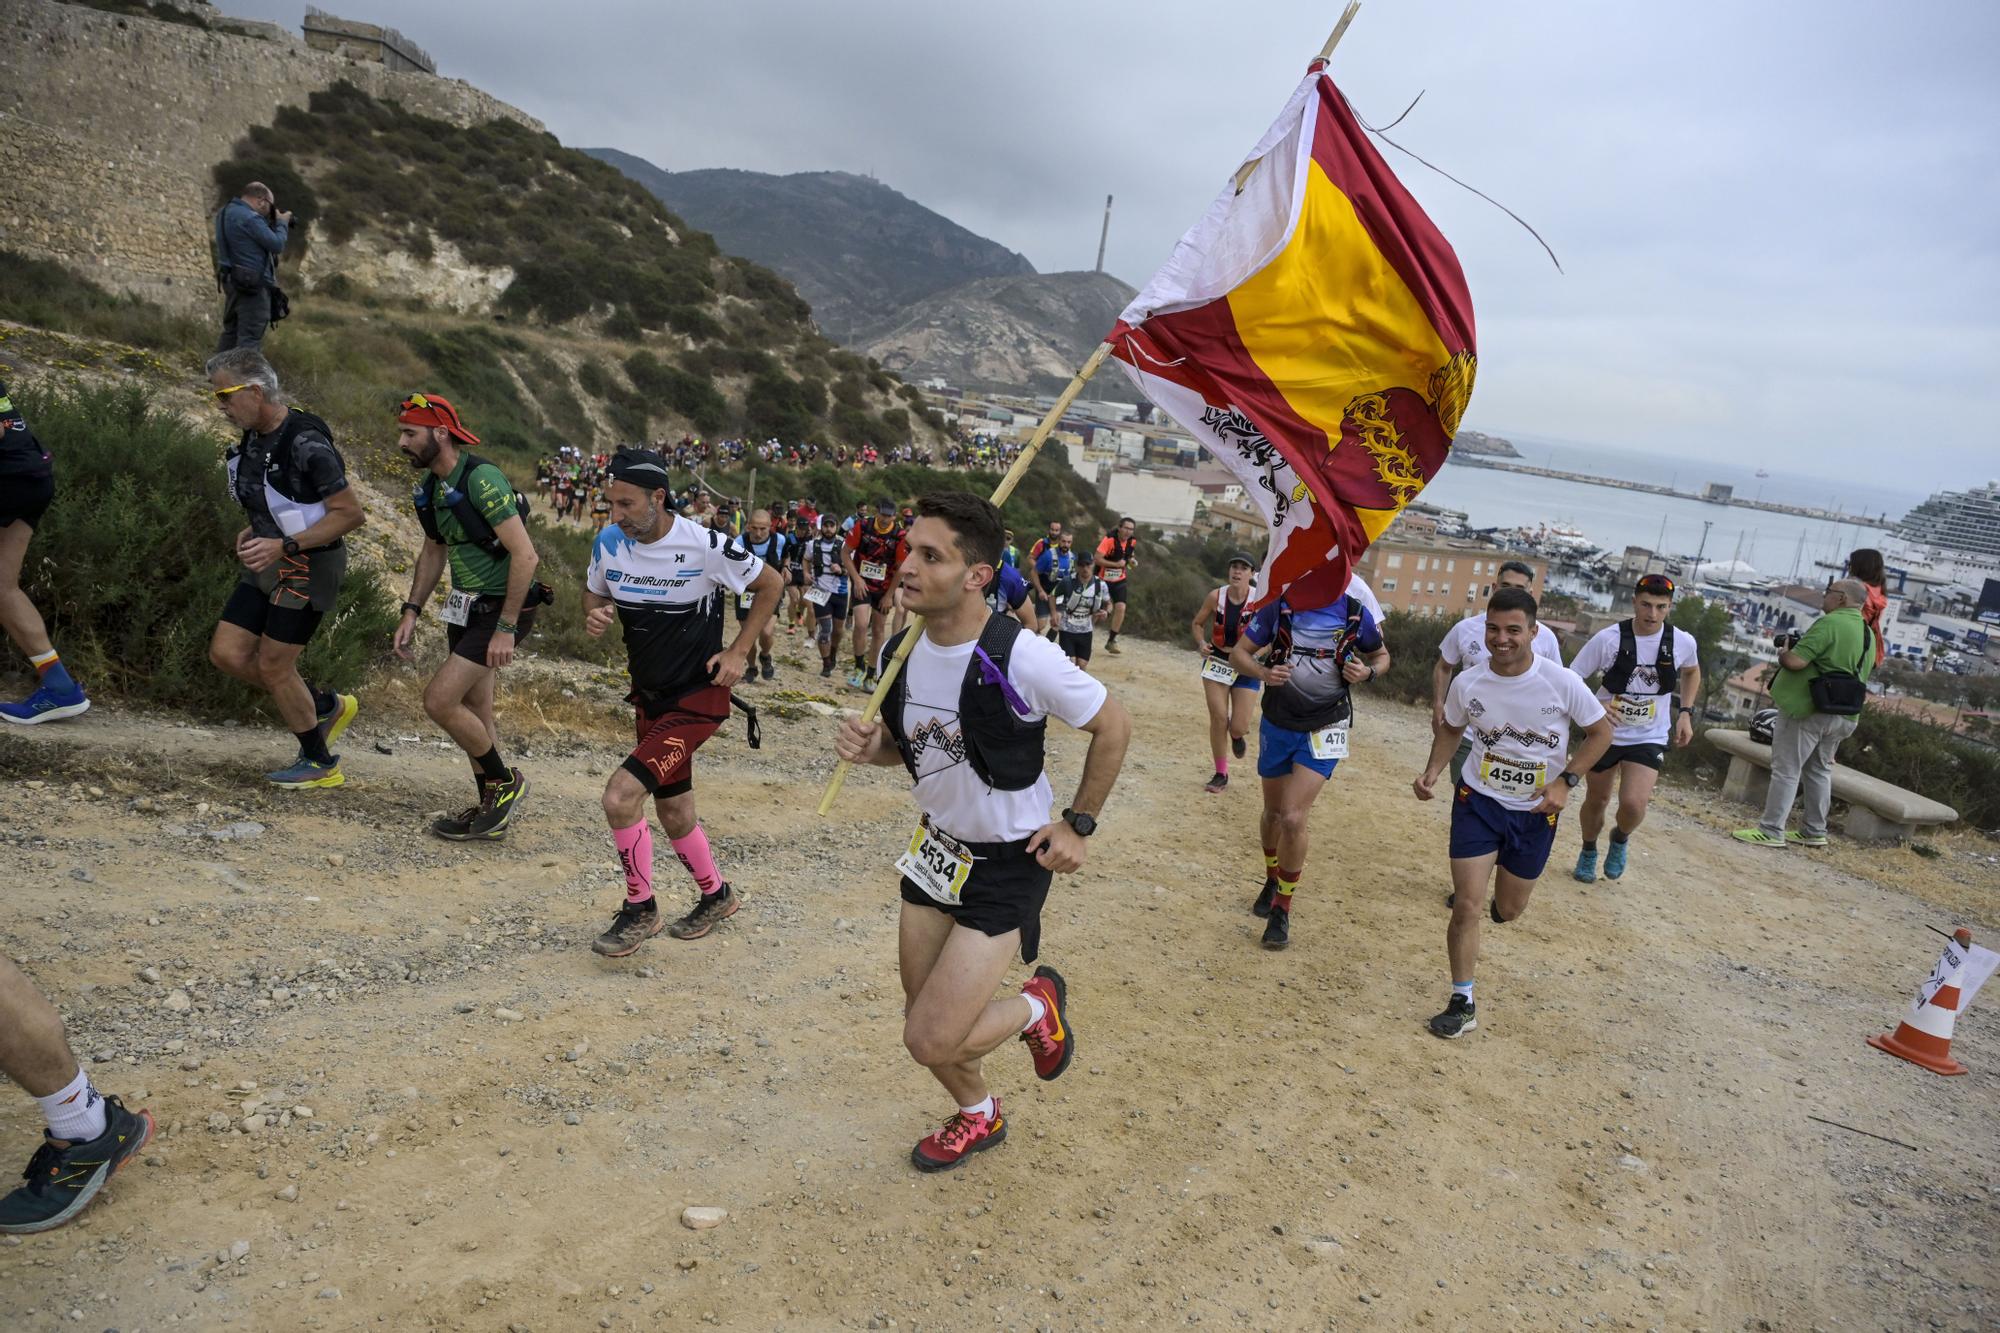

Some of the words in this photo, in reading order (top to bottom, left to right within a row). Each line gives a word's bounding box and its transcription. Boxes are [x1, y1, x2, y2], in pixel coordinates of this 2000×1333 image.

[1210, 663, 1234, 677] 2392
[1325, 732, 1346, 745] 478
[1489, 767, 1536, 787] 4549
[919, 838, 958, 883] 4534
